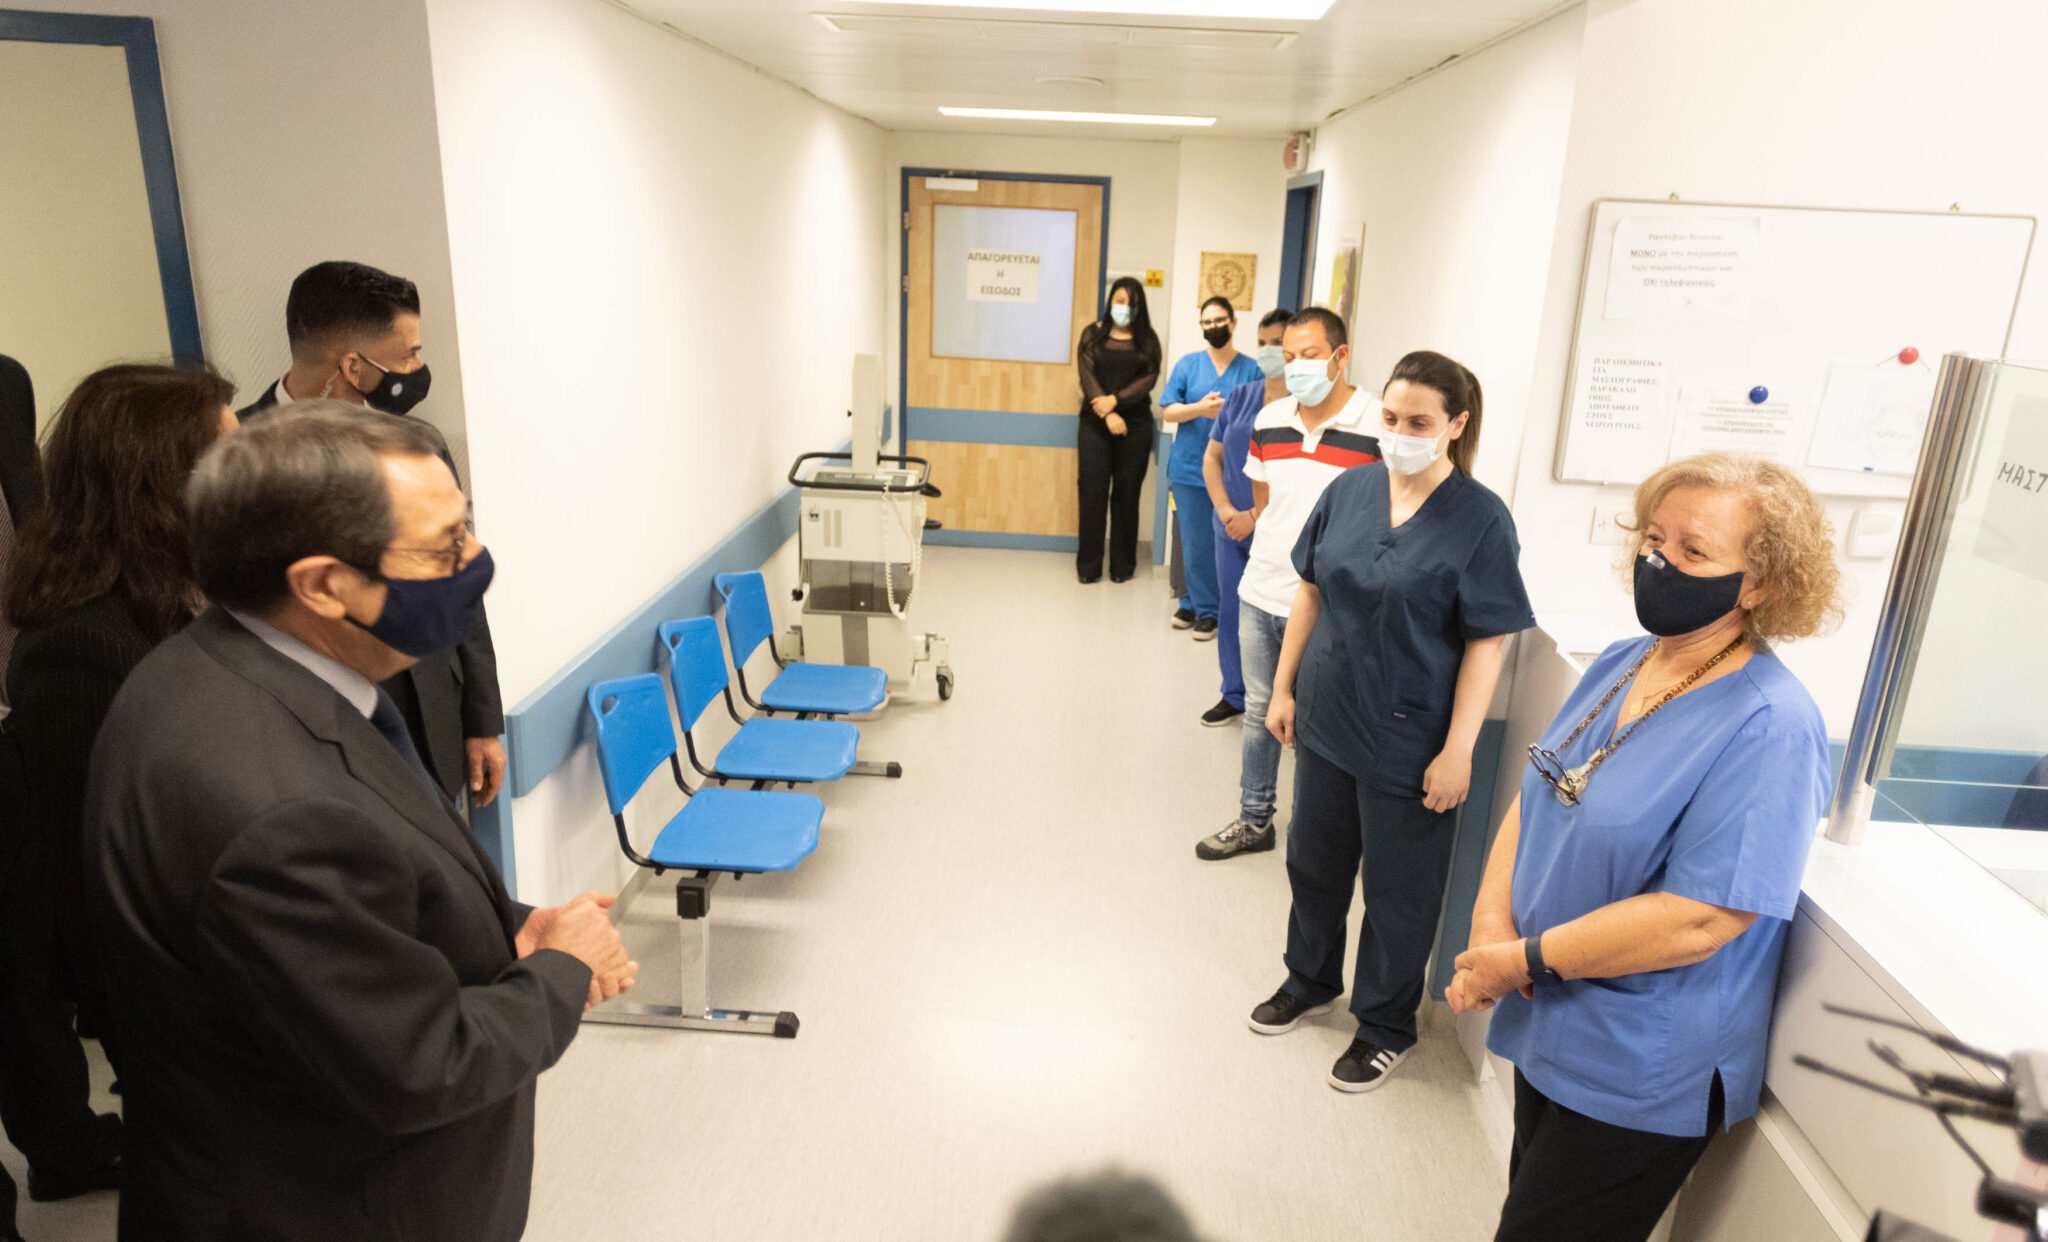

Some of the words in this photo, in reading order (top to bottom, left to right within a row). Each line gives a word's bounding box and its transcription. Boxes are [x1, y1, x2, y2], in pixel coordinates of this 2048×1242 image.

[967, 252, 1040, 264] ΑΠΑΓΟΡΕΥΕΤΑΙ
[1630, 248, 1657, 258] ΜΟΝΟ
[997, 270, 1004, 279] Η
[981, 286, 1021, 296] ΕΙΣΟΔΟΣ
